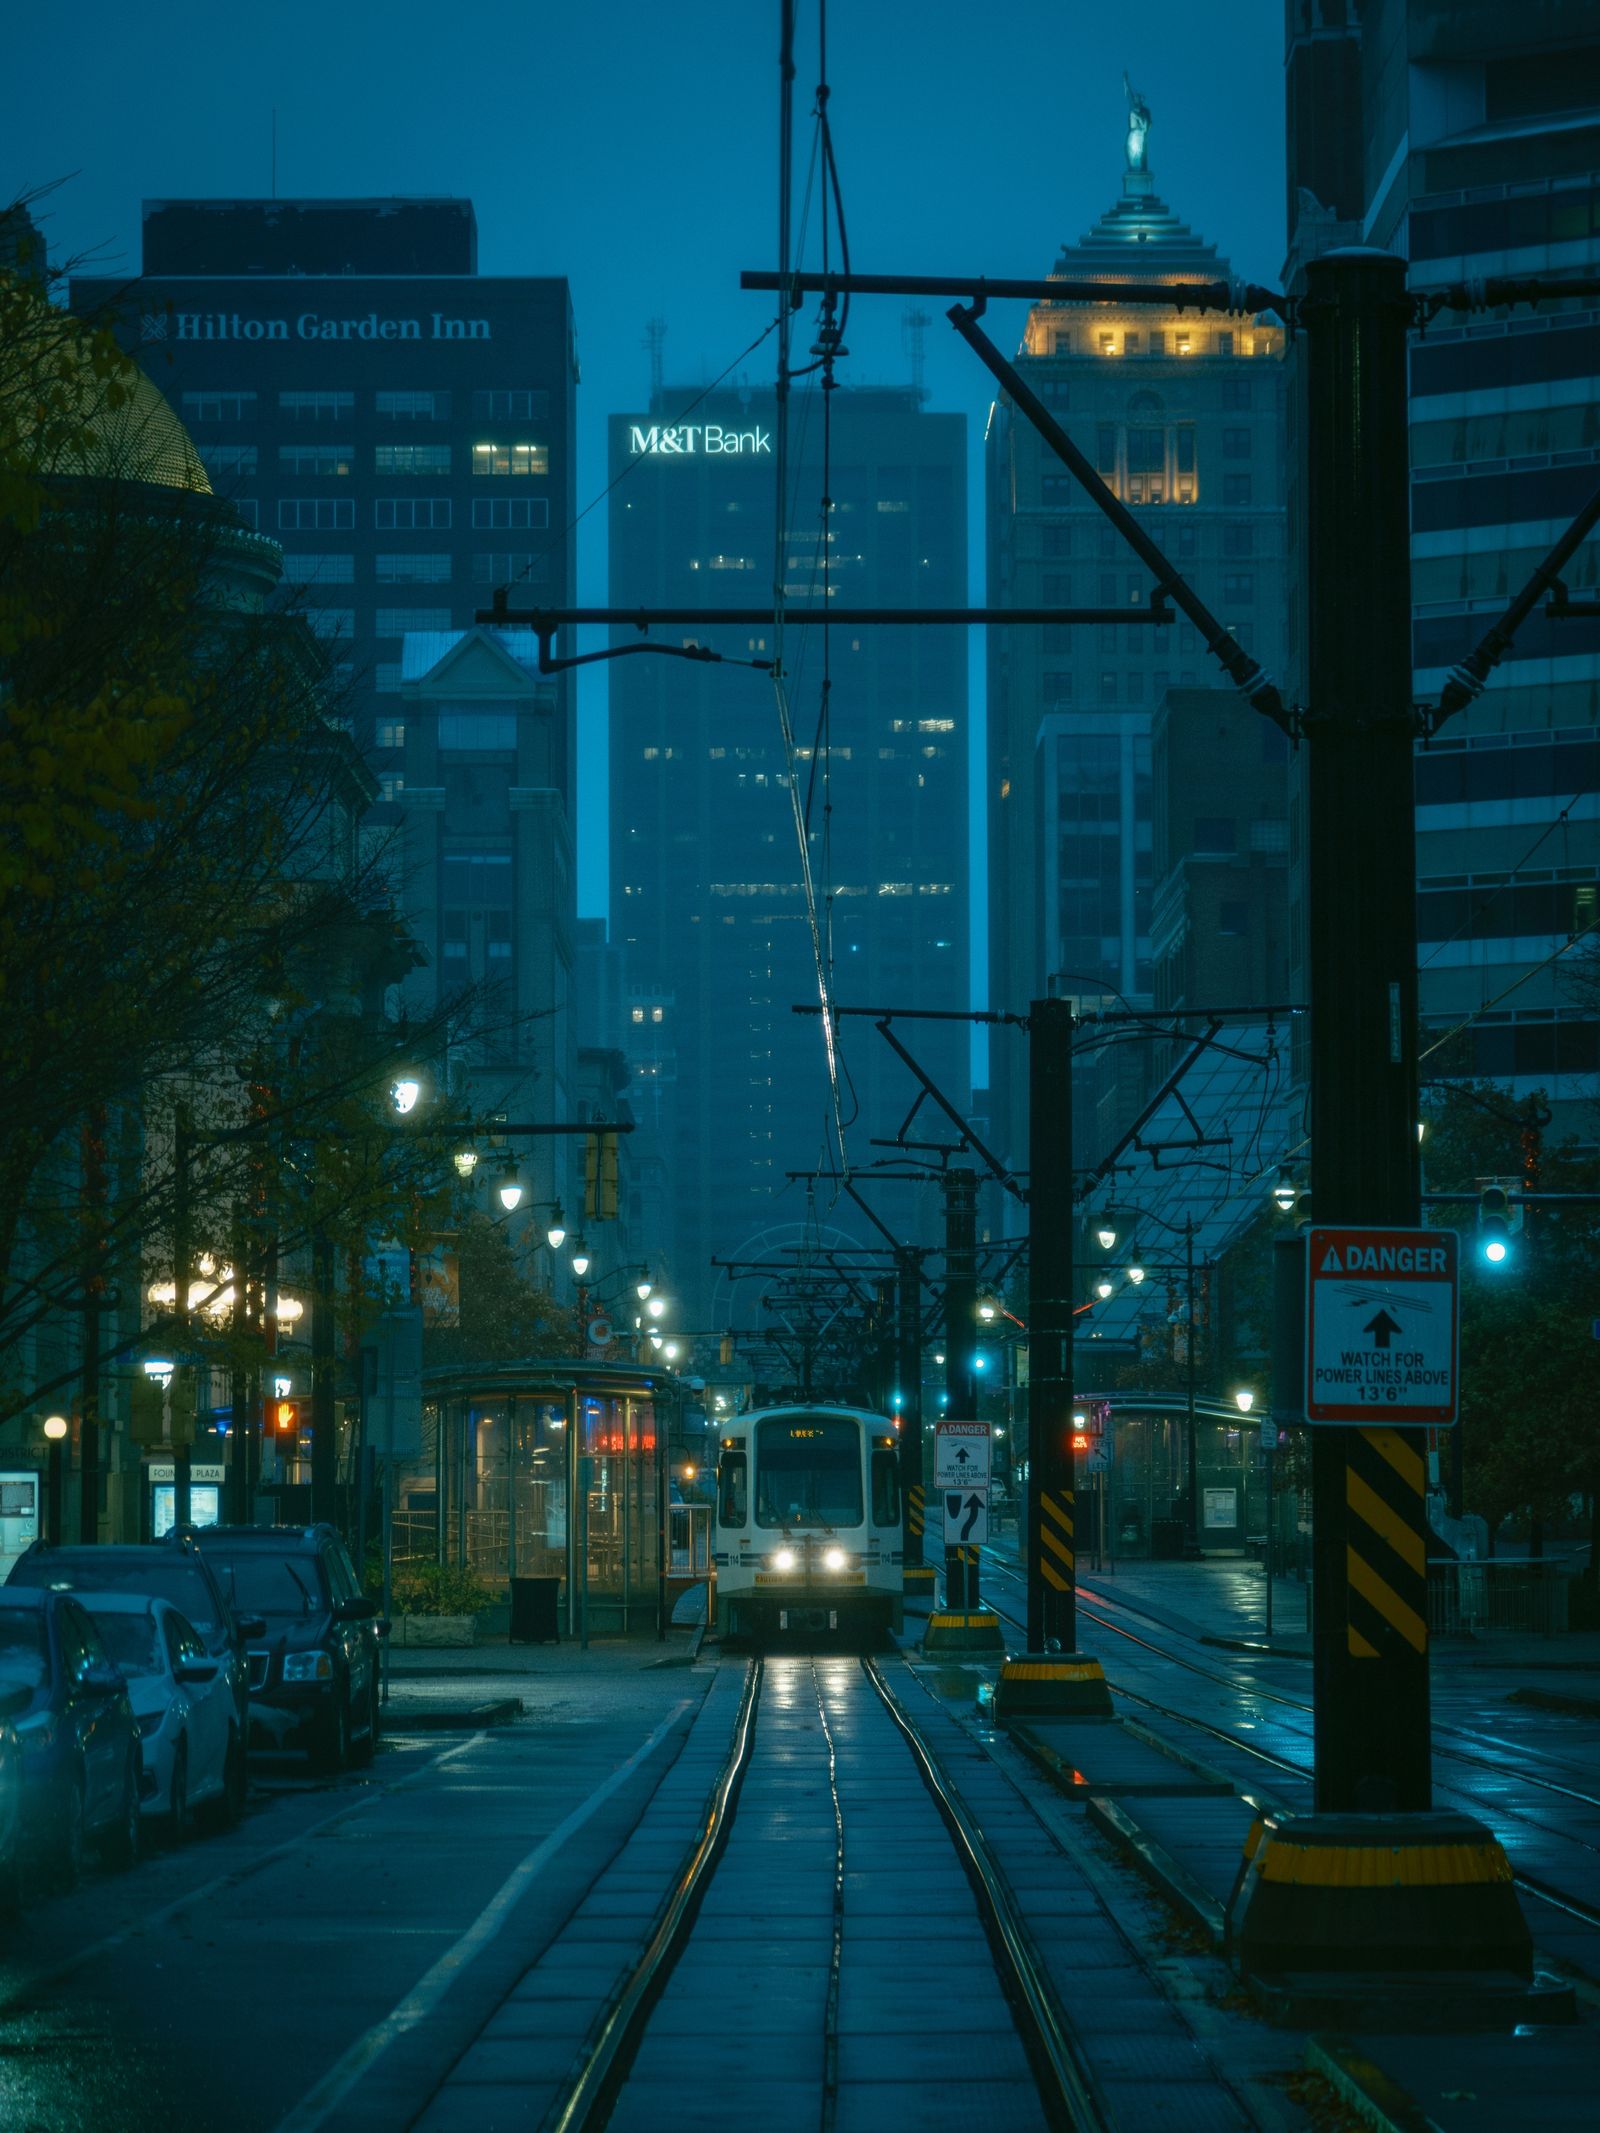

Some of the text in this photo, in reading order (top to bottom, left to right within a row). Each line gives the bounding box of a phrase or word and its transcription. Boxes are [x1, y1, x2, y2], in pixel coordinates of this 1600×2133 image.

[176, 312, 492, 341] Hilton Garden Inn
[629, 424, 772, 454] M&T Bank
[1346, 1245, 1447, 1273] DANGER
[1341, 1352, 1424, 1367] WATCH FOR
[1316, 1368, 1449, 1386] POWER LINES ABOVE
[1358, 1386, 1408, 1402] 13'6"
[948, 1424, 987, 1434] DANGER
[196, 1469, 219, 1478] PLAZA
[729, 1554, 740, 1567] 114
